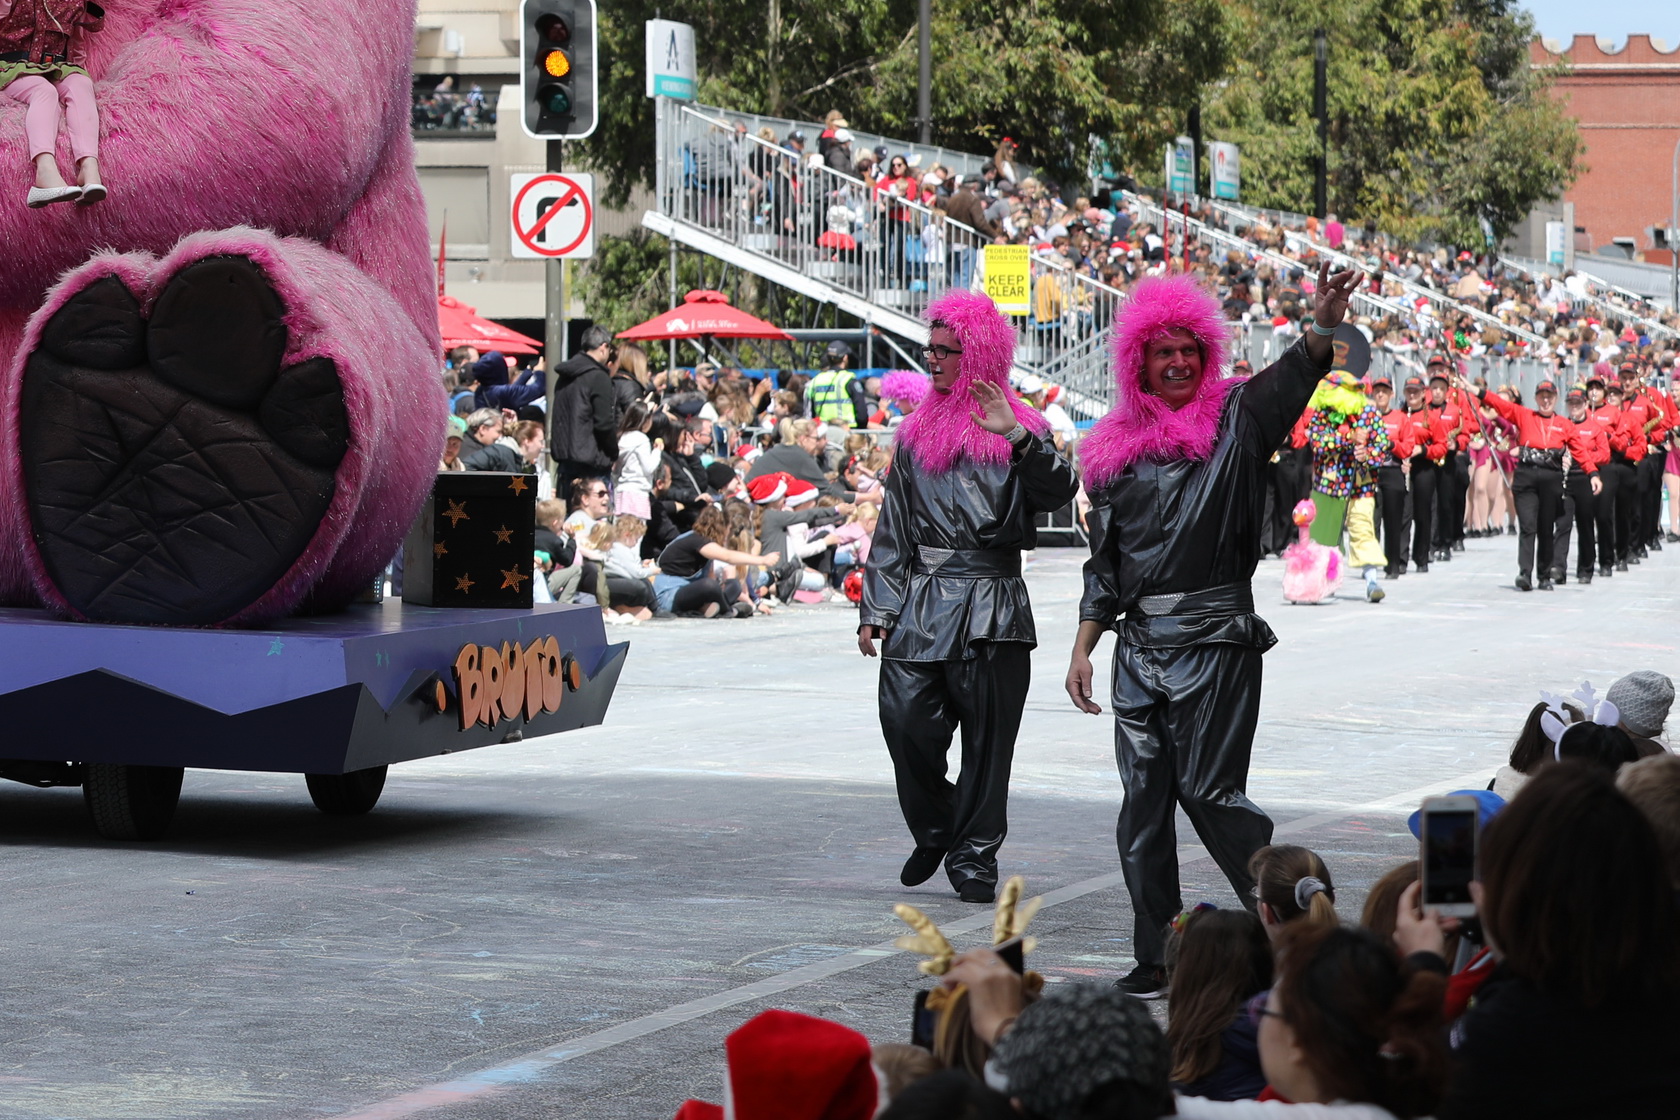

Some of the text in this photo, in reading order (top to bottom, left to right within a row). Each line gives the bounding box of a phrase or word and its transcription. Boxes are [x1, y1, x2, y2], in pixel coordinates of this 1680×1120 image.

[988, 275, 1025, 285] KEEP
[988, 286, 1025, 297] CLEAR
[455, 634, 563, 730] BRUTO
